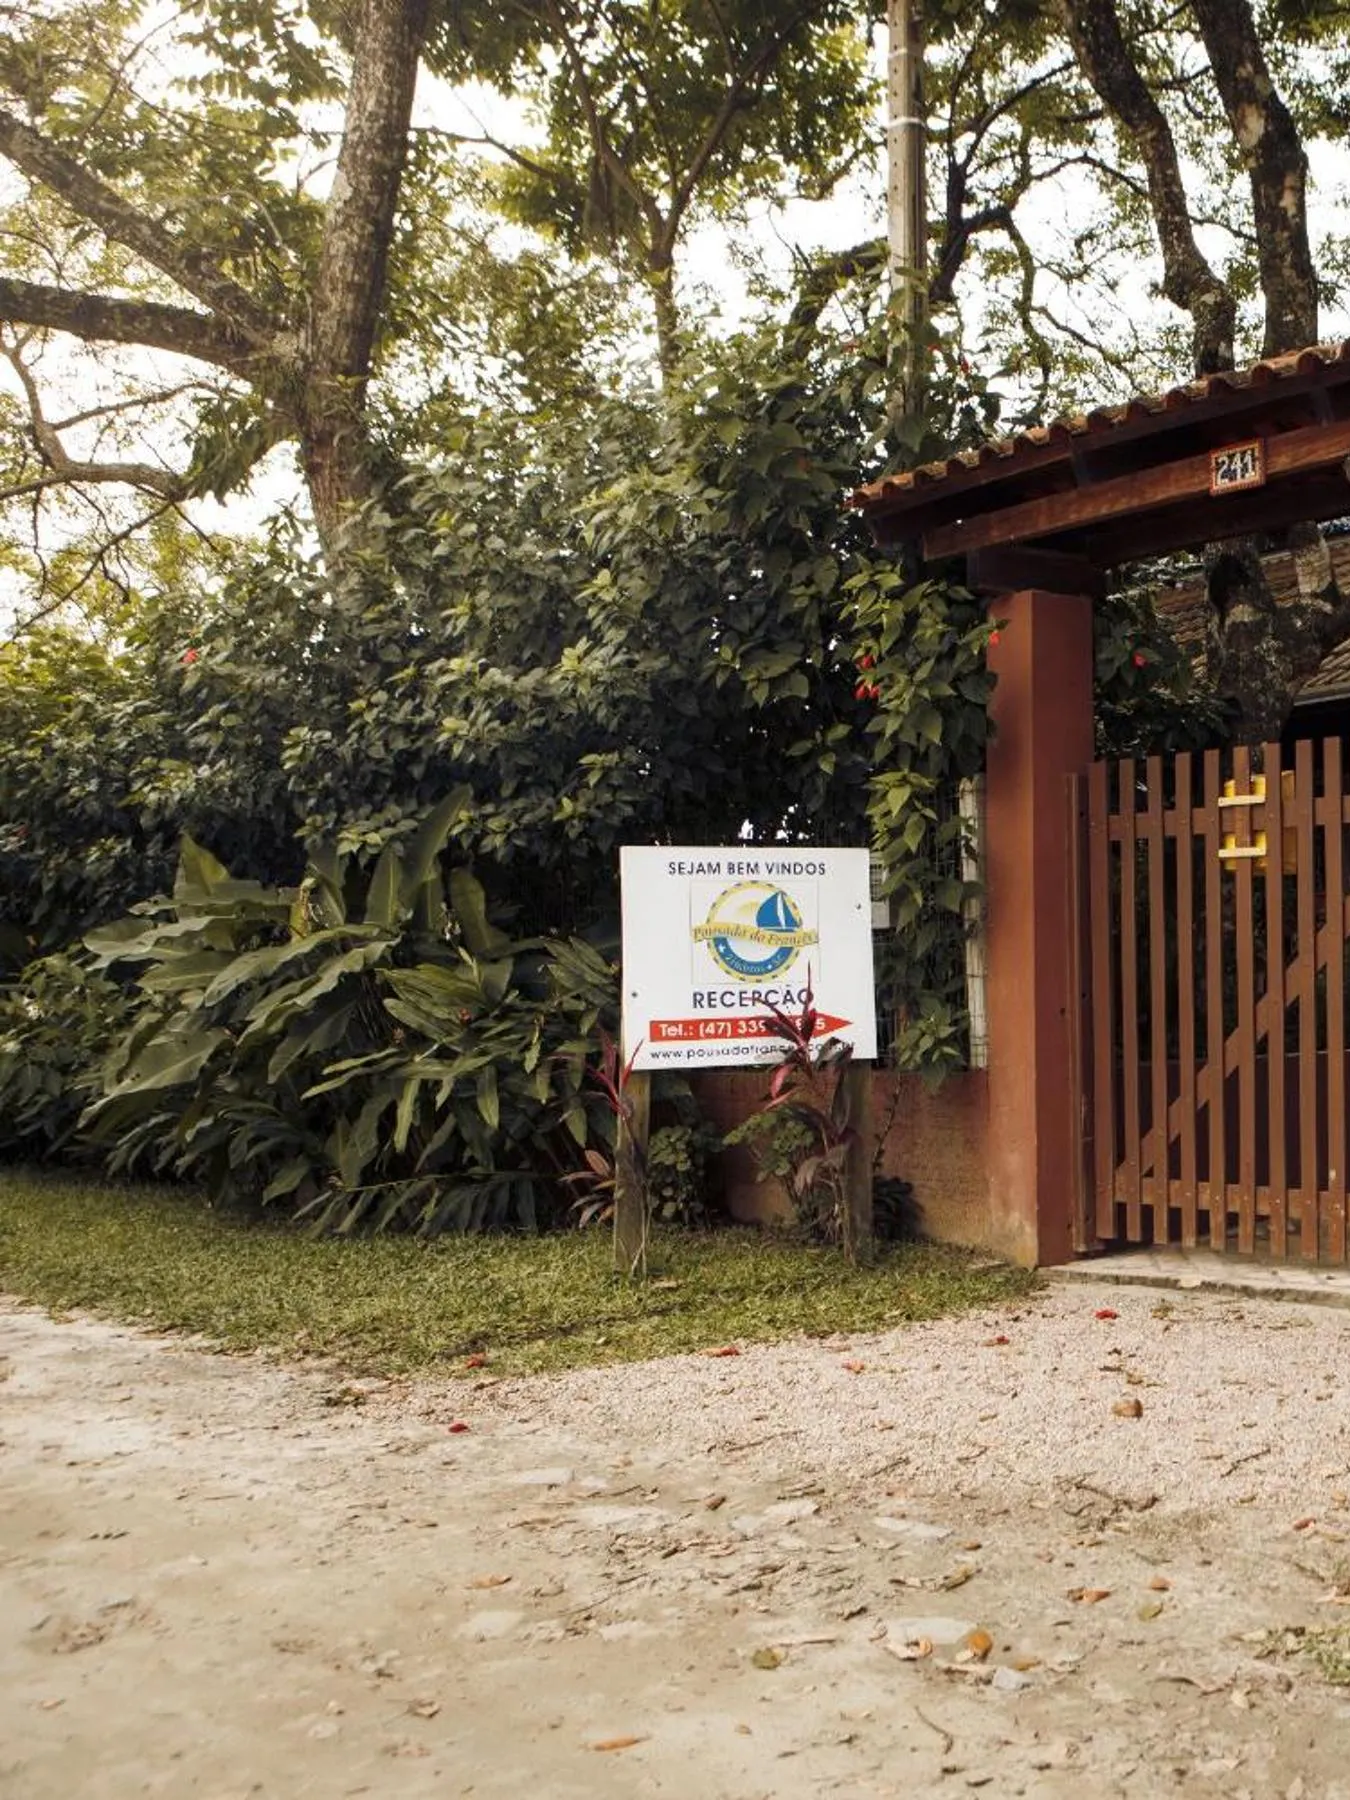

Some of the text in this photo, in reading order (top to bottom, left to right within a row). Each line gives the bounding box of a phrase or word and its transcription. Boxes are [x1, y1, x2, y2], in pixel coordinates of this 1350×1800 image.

[1217, 449, 1256, 485] 241
[668, 860, 826, 876] SEJAM BEM VINDOS
[659, 1021, 694, 1037] Tel.:
[699, 1021, 732, 1038] (47)
